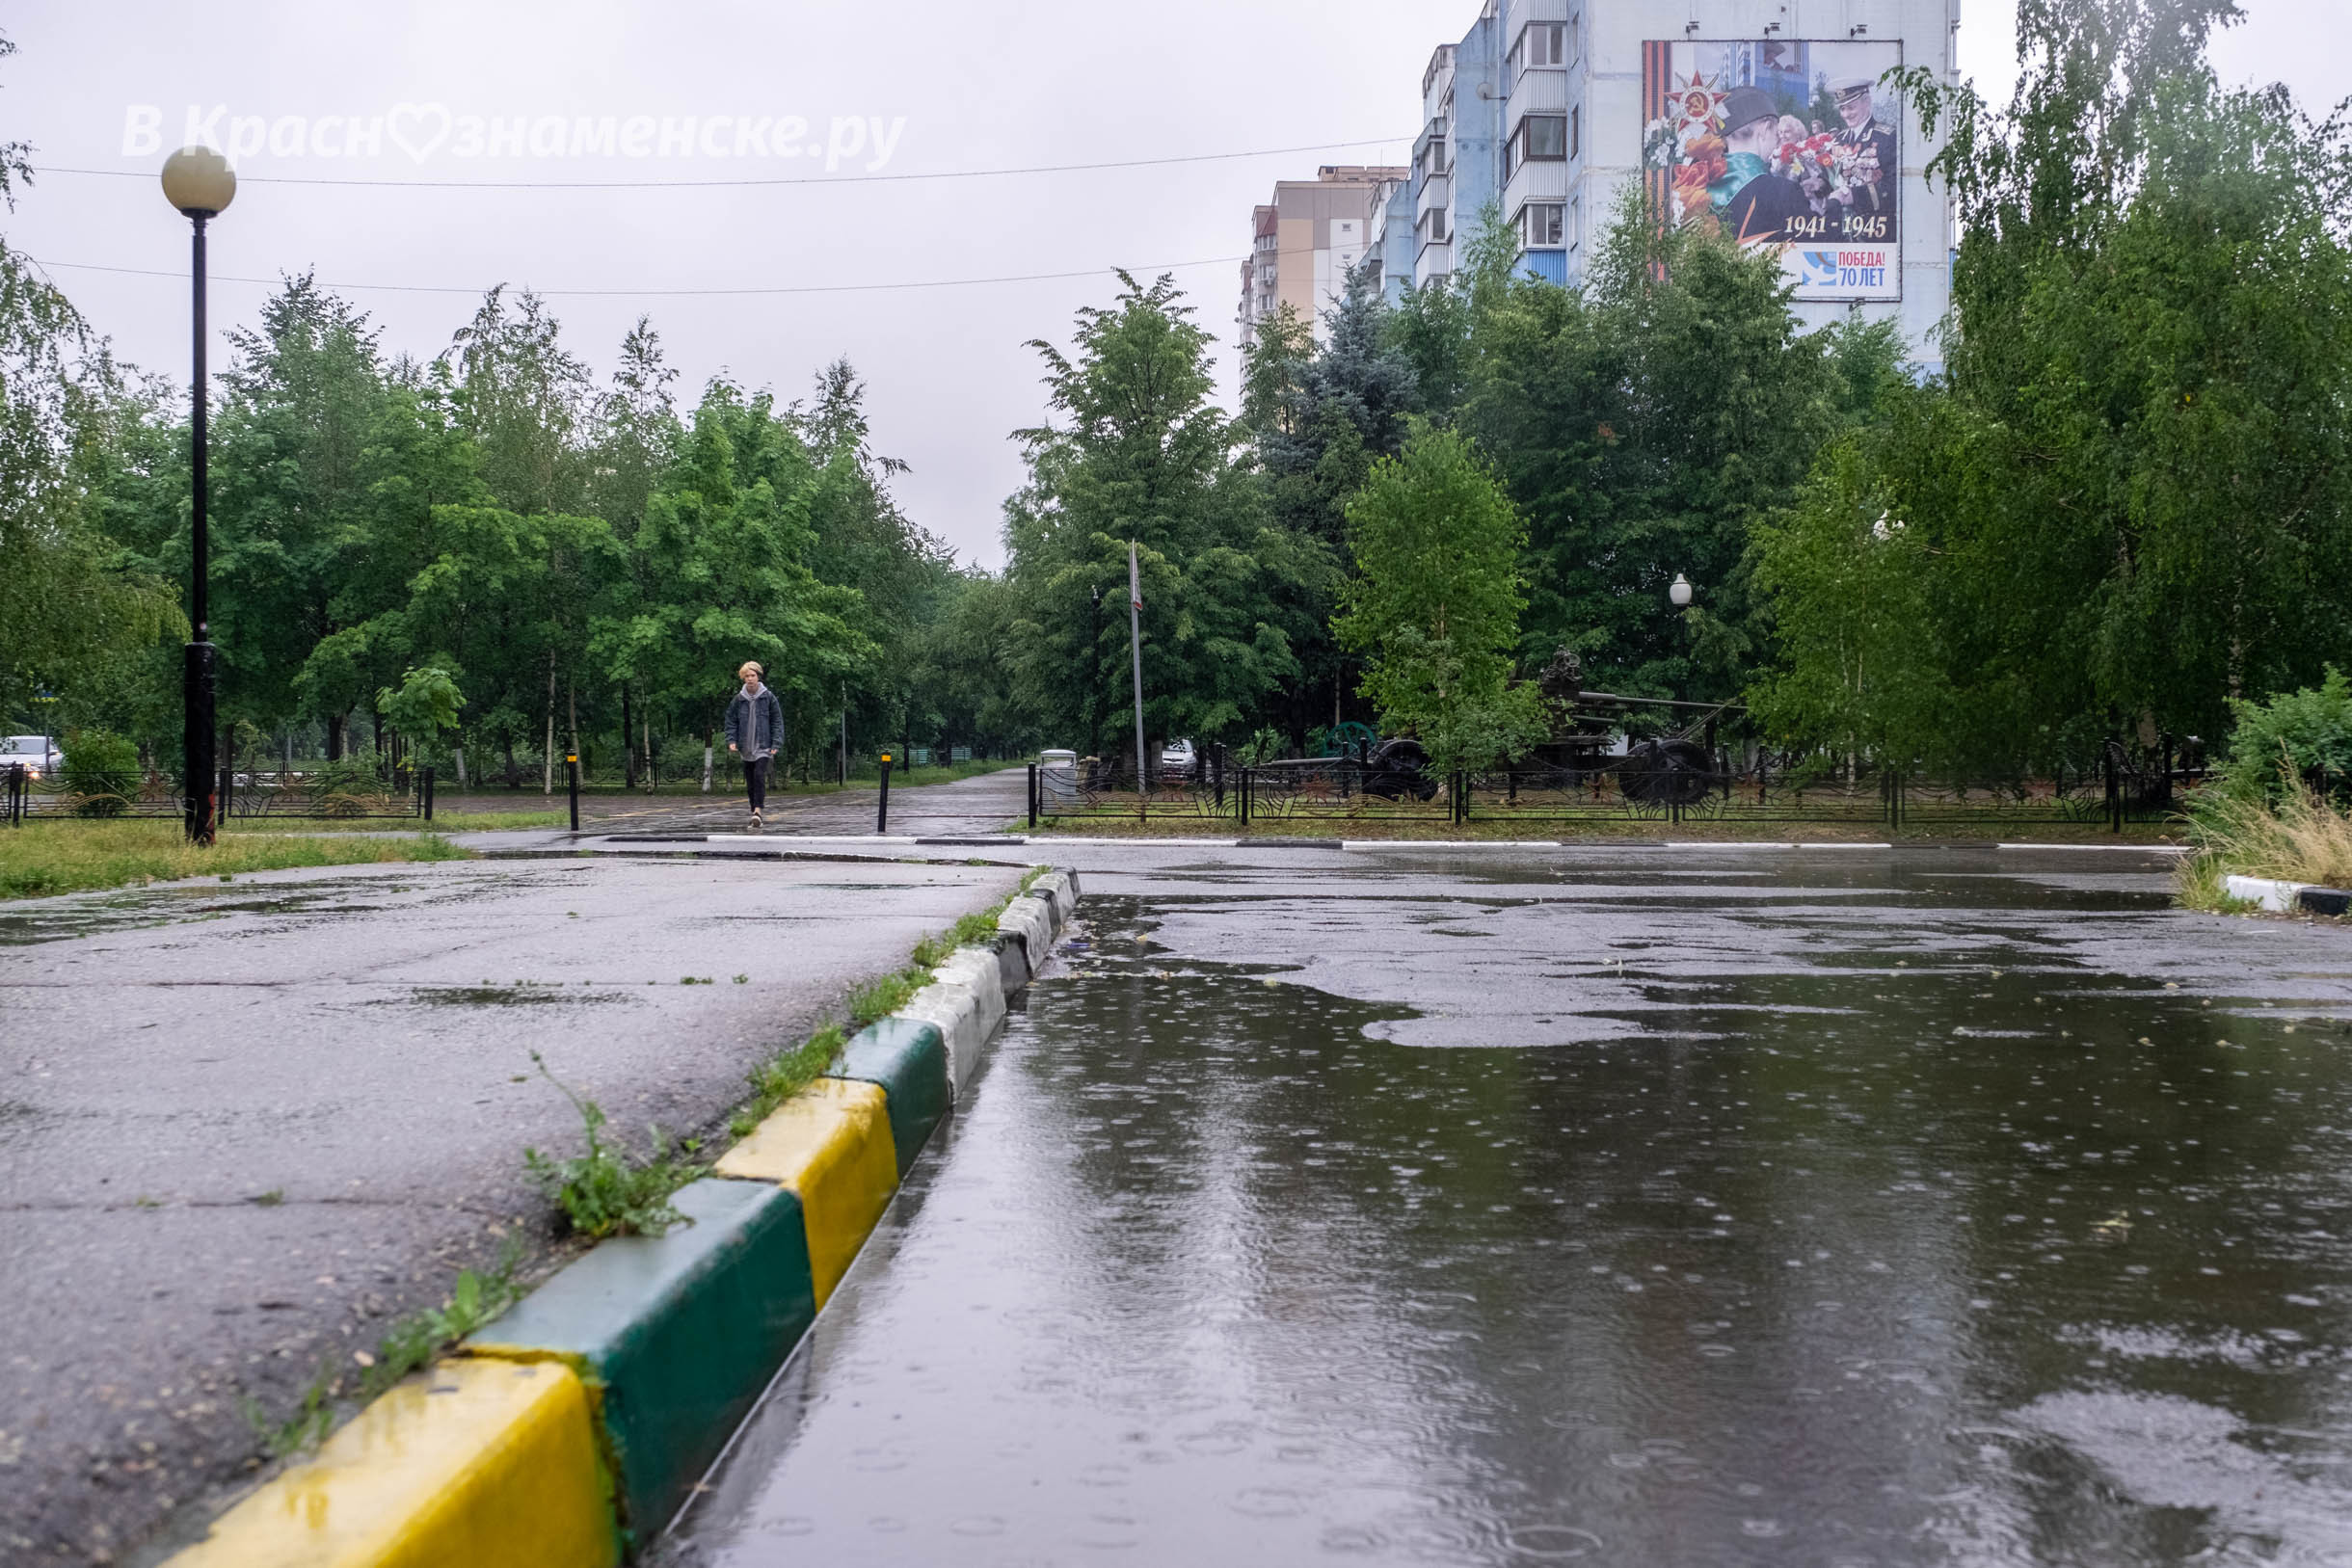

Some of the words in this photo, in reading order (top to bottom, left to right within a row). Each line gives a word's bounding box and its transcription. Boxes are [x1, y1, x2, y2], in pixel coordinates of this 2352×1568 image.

[1784, 215, 1827, 238] 1941
[1842, 215, 1887, 238] 1945
[1838, 252, 1885, 266] ПОБЕДА!
[1839, 268, 1857, 286] 70
[1859, 268, 1885, 286] ЛЕТ
